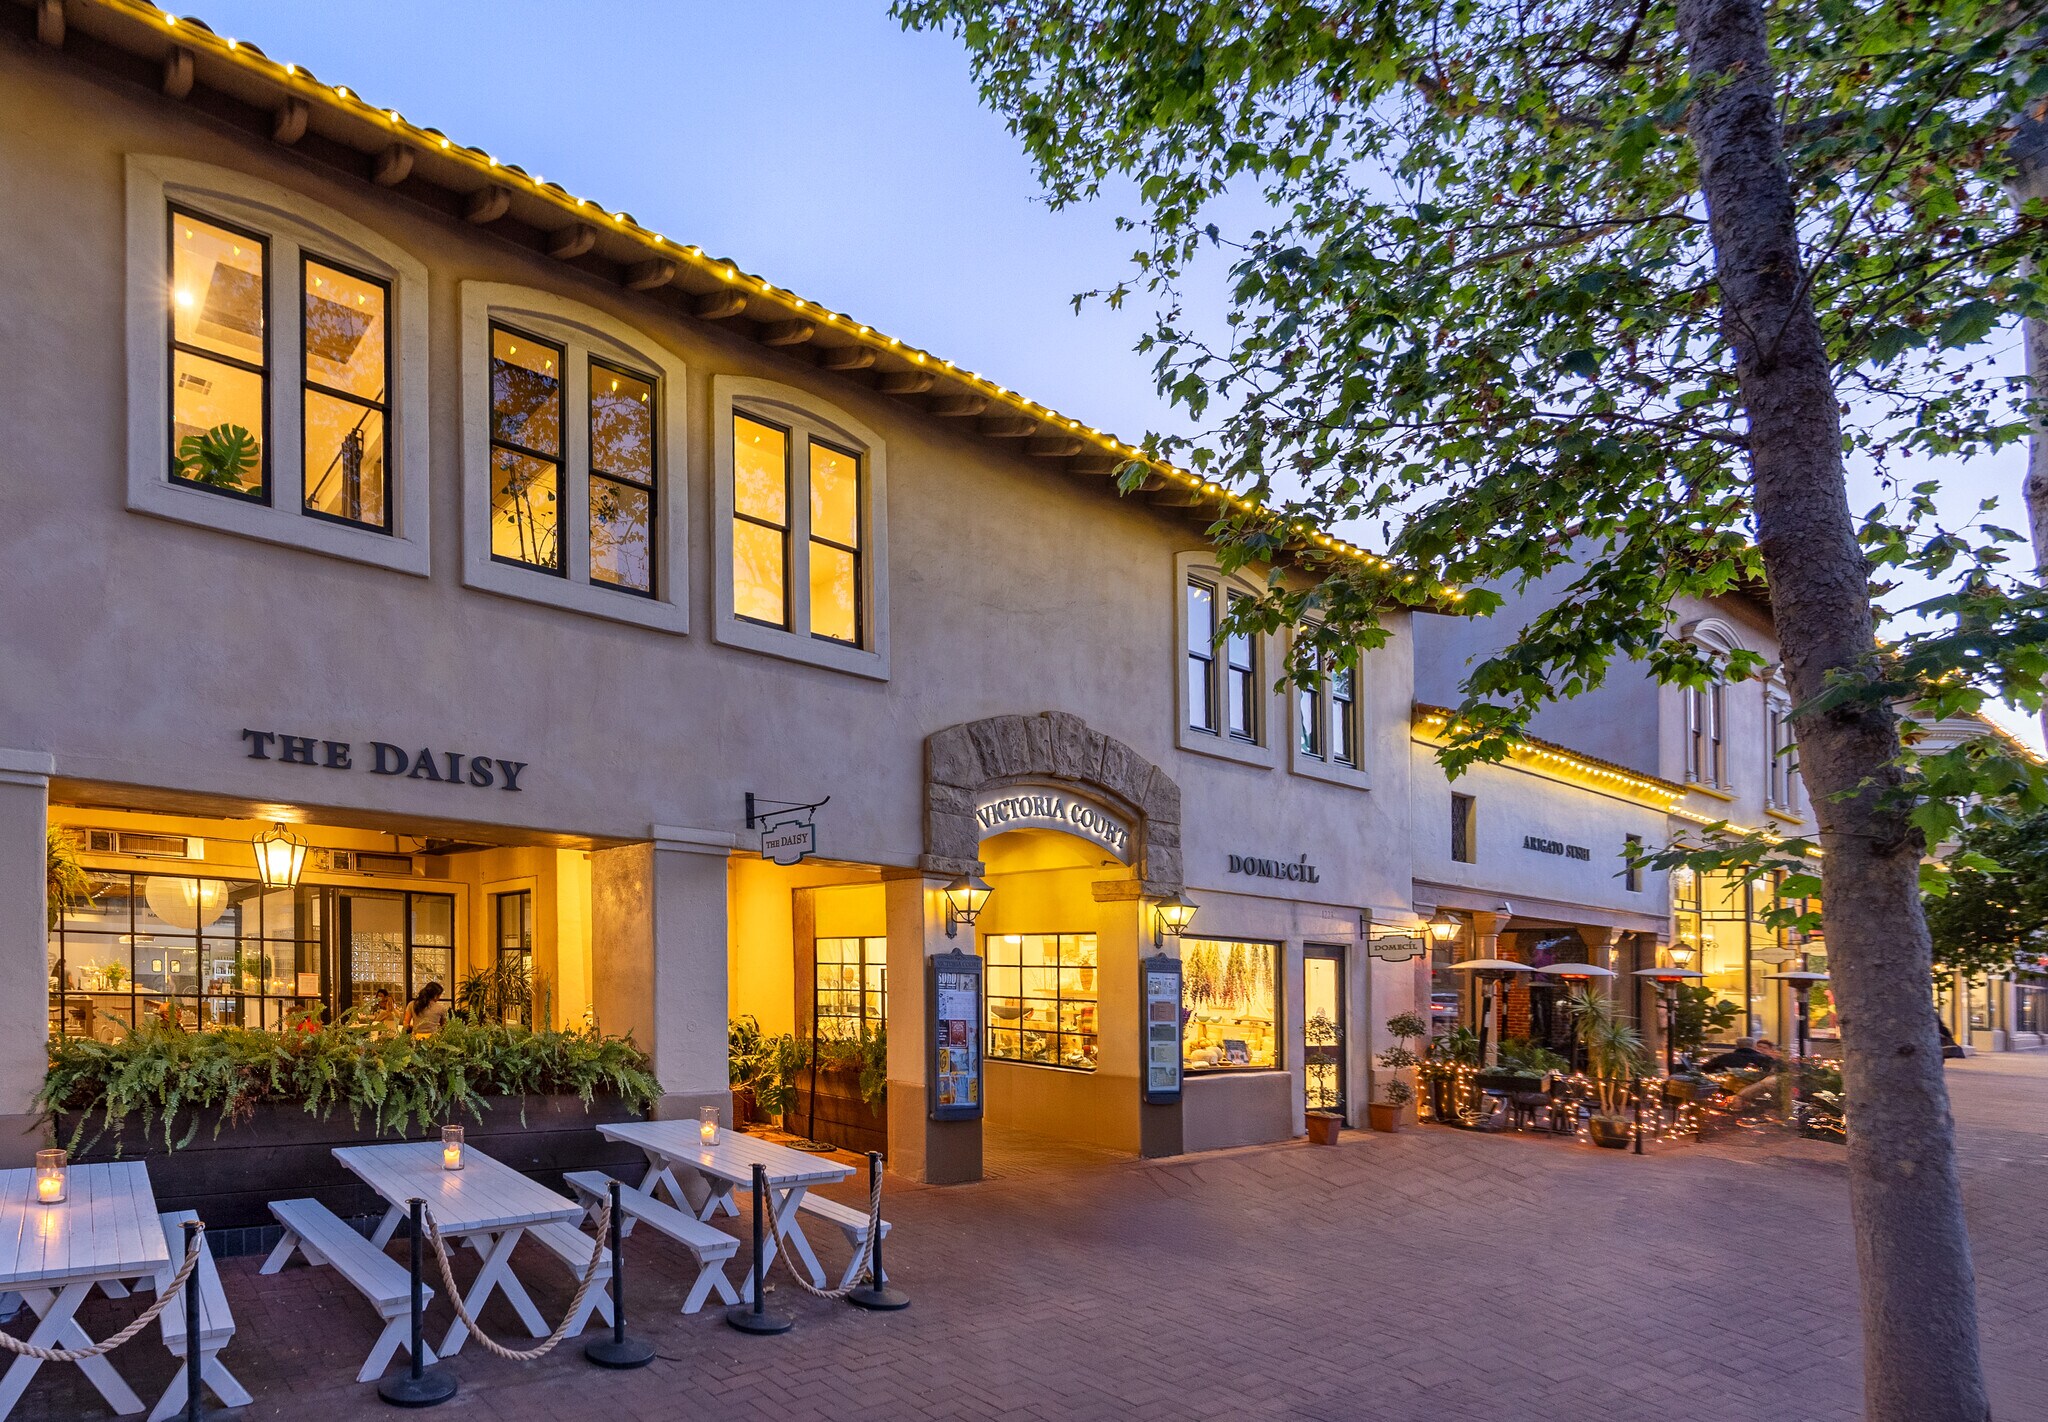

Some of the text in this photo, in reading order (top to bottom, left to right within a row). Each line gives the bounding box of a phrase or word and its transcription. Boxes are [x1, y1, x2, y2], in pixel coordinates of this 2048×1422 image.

[242, 728, 528, 792] THE DAISY
[766, 833, 808, 849] THE DAISY
[976, 796, 1130, 849] VICTORIA COURT
[1523, 836, 1590, 861] ARIGATO SUSHI
